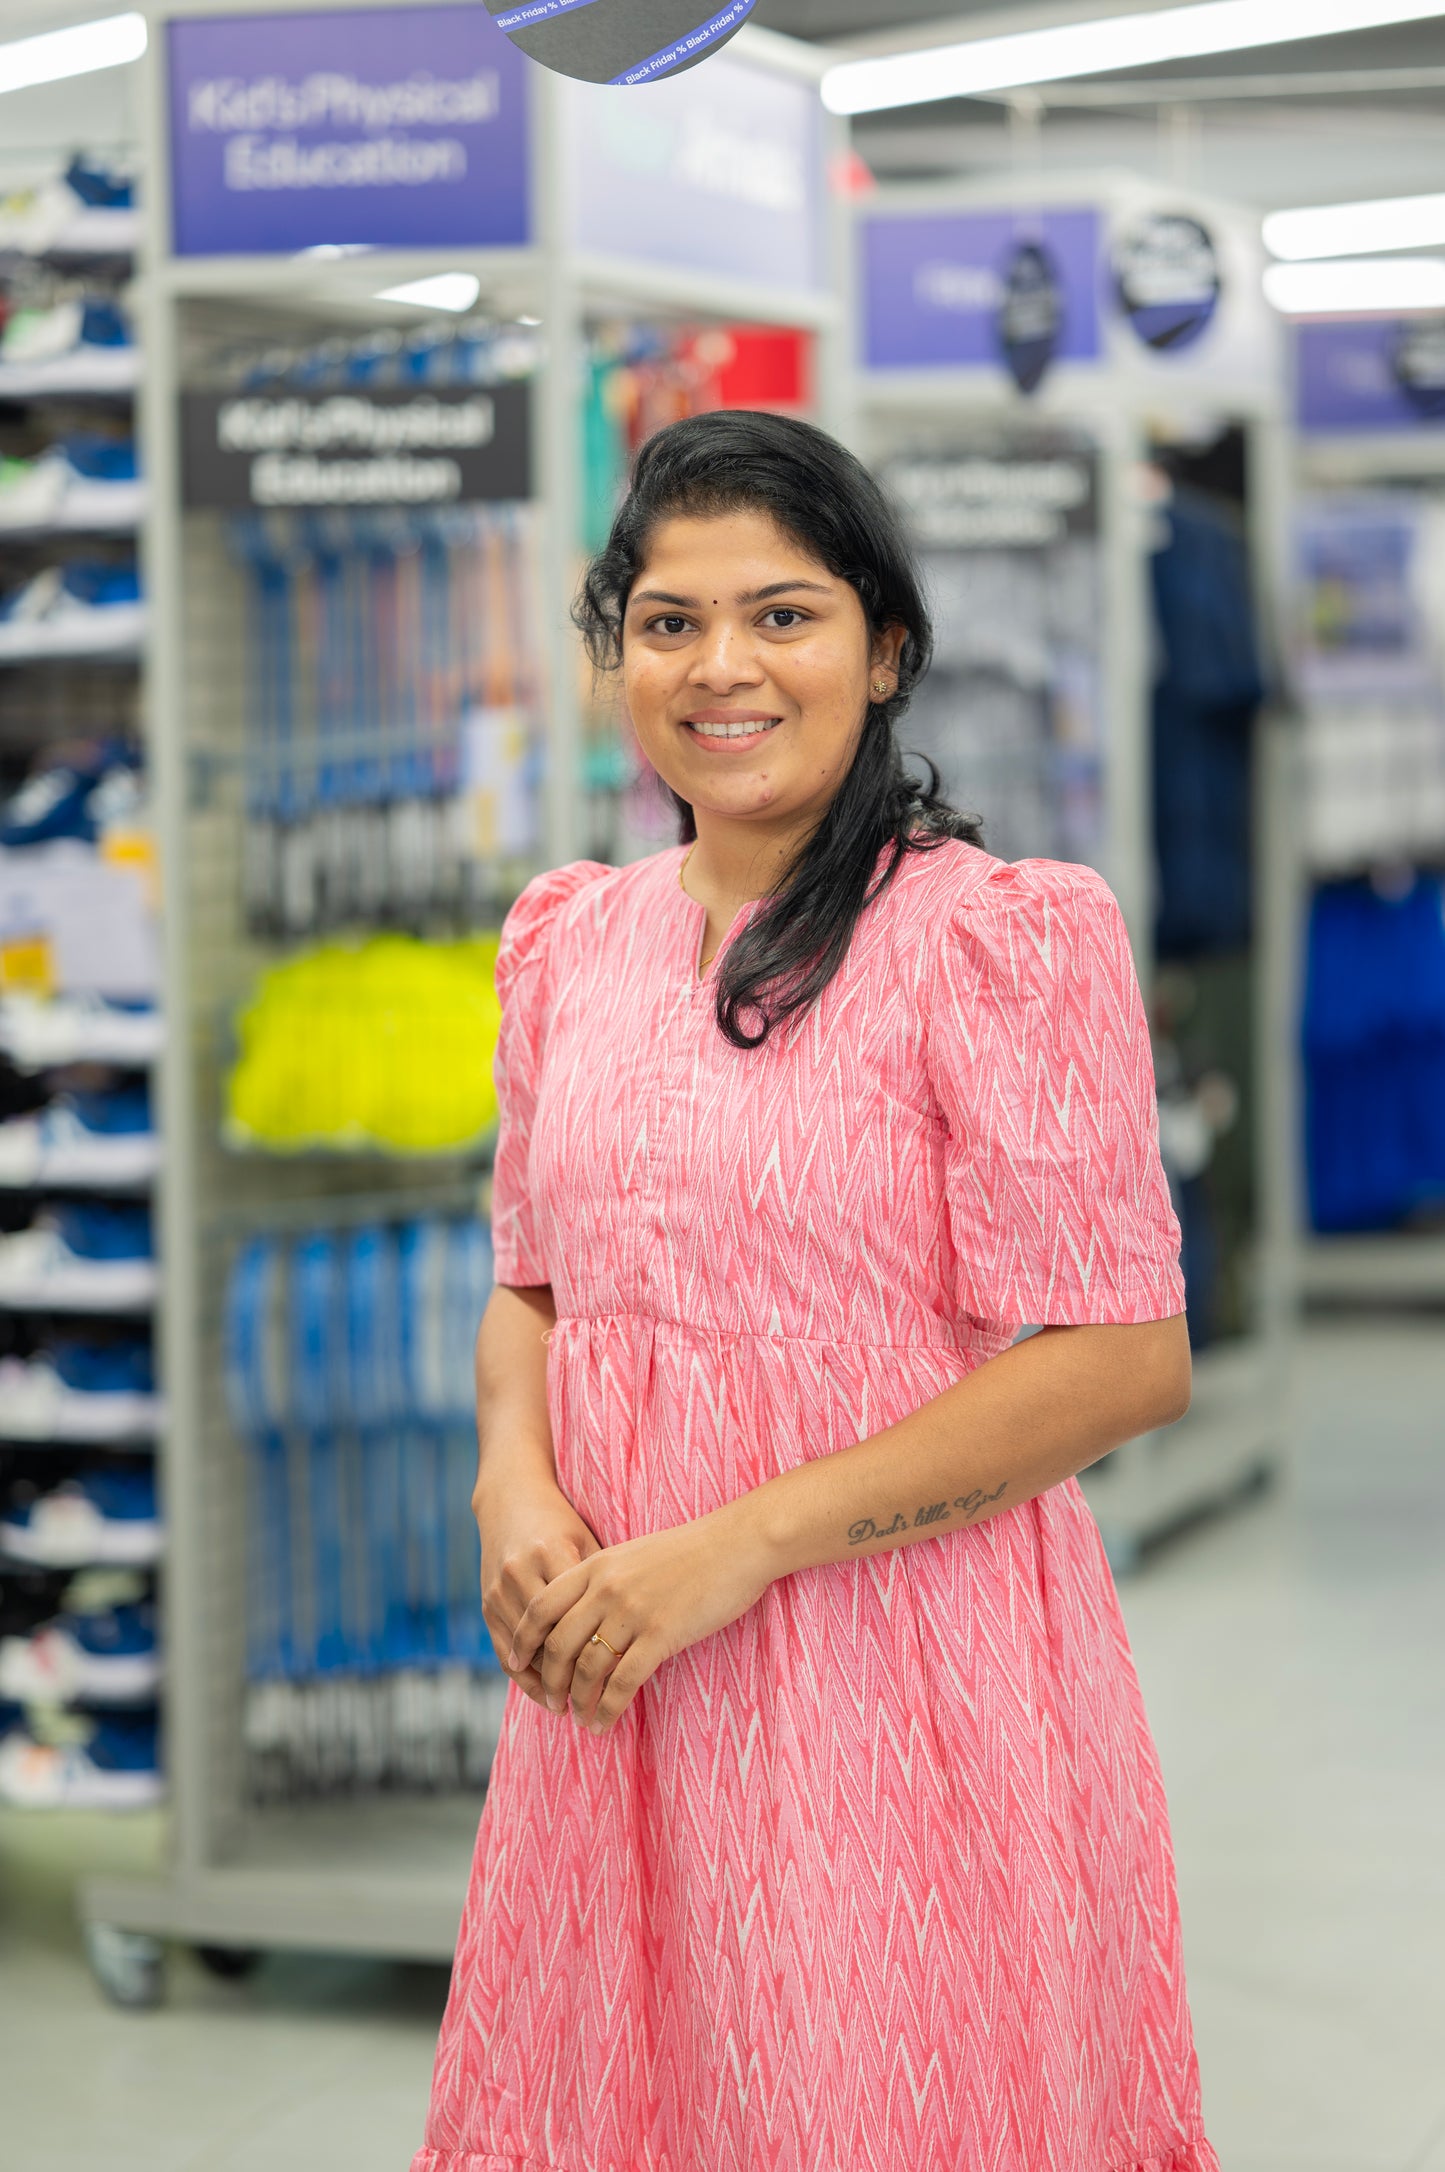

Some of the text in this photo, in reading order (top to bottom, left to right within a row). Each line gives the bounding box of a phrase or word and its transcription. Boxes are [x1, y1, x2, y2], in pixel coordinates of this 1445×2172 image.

[497, 15, 522, 28] Black
[521, 6, 548, 20] Friday
[625, 67, 651, 85] Black
[649, 51, 677, 71] Friday
[686, 30, 711, 49] Black
[709, 11, 735, 34] Friday
[302, 67, 499, 138] Physical
[224, 134, 467, 190] Education
[250, 453, 462, 505] Education
[848, 1481, 1008, 1546] Dad's little Girl
